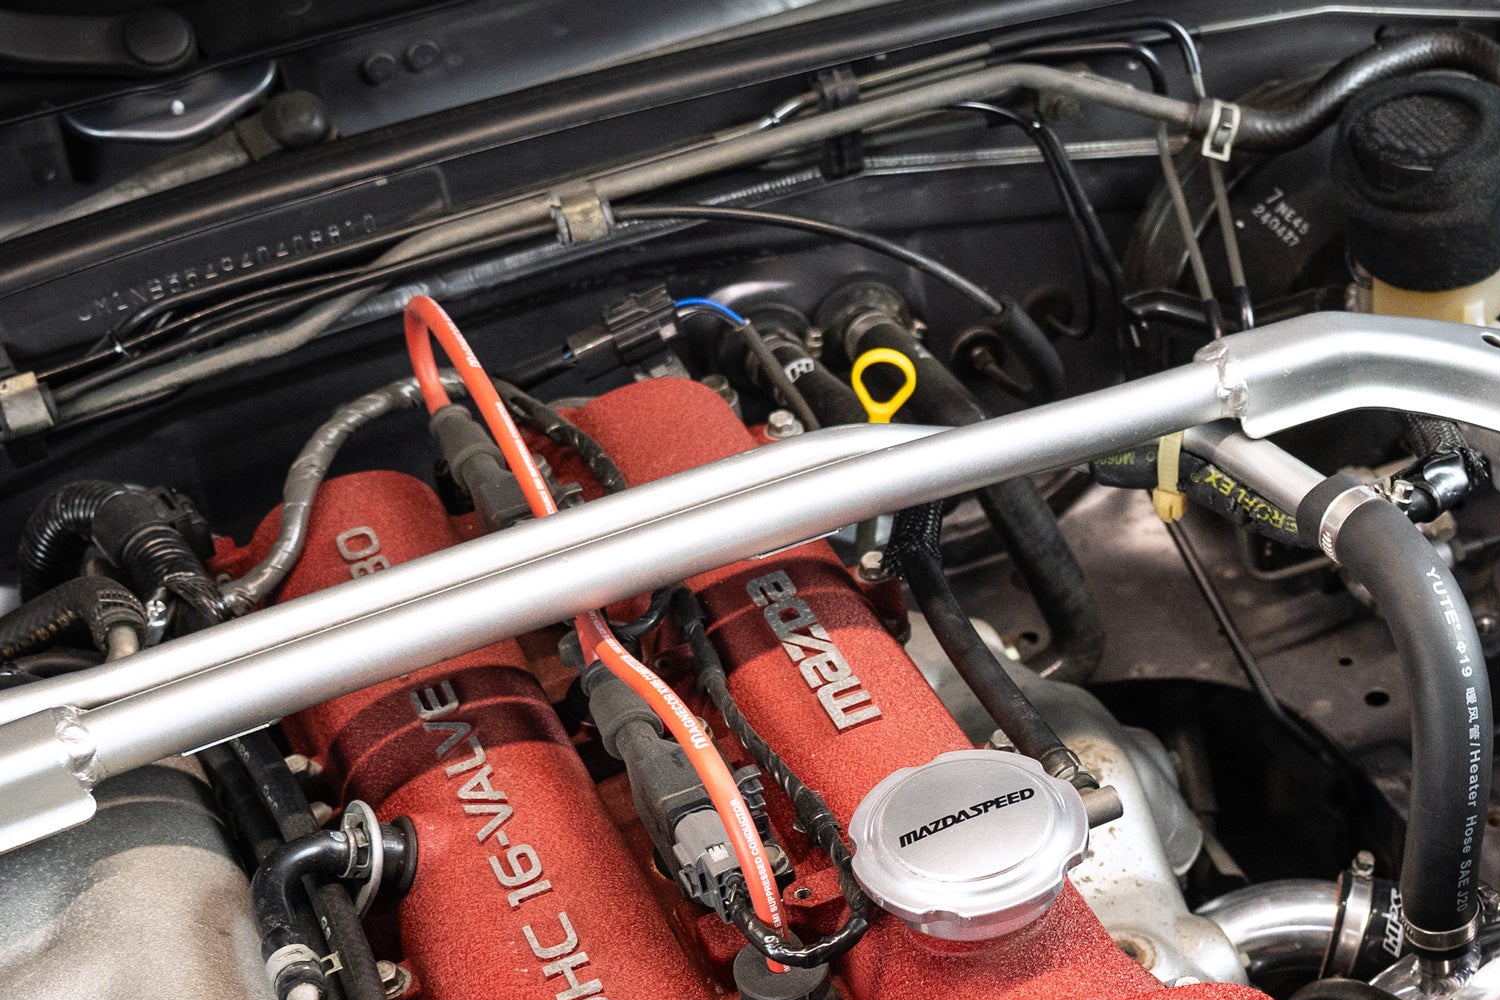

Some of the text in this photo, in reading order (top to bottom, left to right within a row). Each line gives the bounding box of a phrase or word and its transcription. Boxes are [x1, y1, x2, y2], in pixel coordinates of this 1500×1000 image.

[746, 570, 882, 731] mazda
[410, 680, 553, 908] 16-VALVE
[899, 788, 1036, 849] MAZDASPEED
[730, 800, 759, 856] CONDUCTOR
[1462, 815, 1479, 854] Hose
[754, 856, 778, 913] SUPPRESSED
[1458, 858, 1472, 889] SAE
